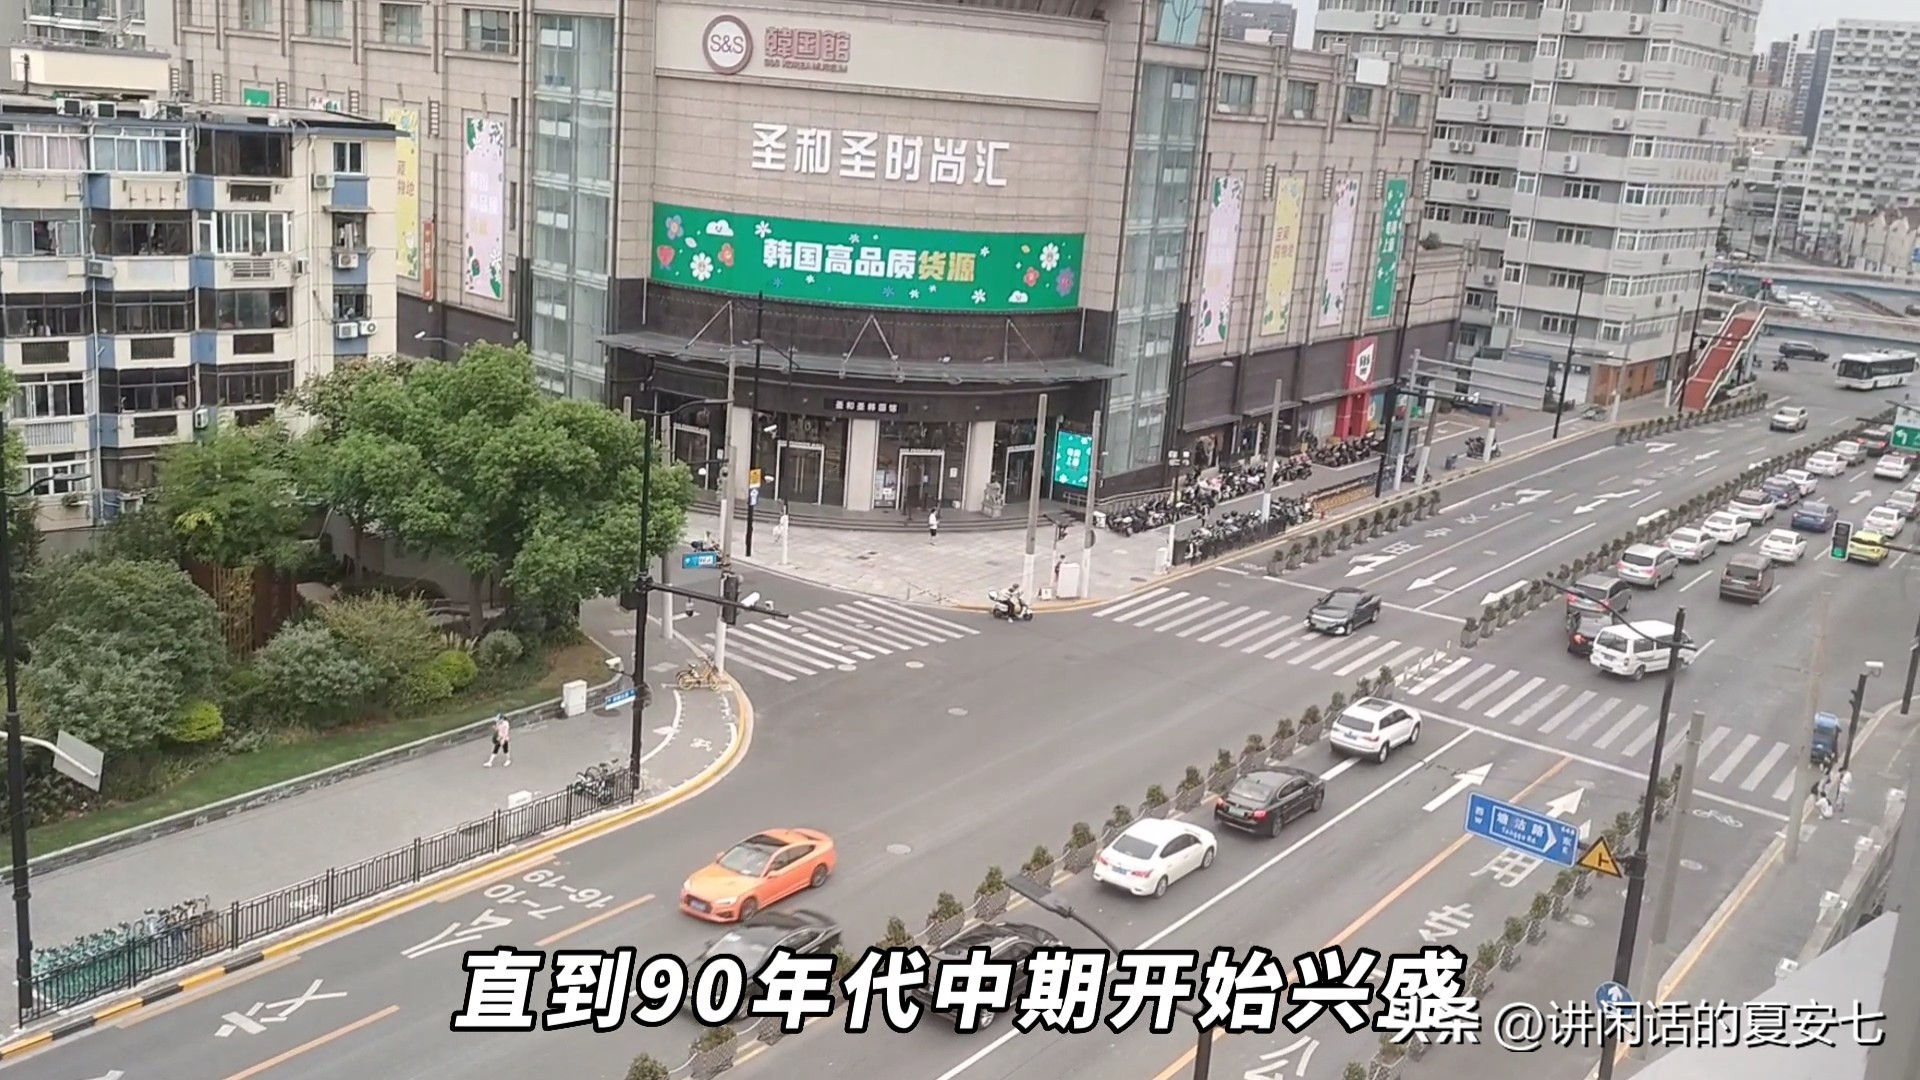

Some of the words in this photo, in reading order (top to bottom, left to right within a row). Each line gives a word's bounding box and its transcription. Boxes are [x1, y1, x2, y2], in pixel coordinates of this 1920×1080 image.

[710, 34, 744, 54] S&S
[751, 122, 1011, 187] 圣和圣时尚汇
[762, 237, 977, 283] 韩国高品质货源
[1496, 811, 1545, 838] 塘沽路
[483, 884, 565, 920] 7-10
[522, 869, 614, 908] 16-19
